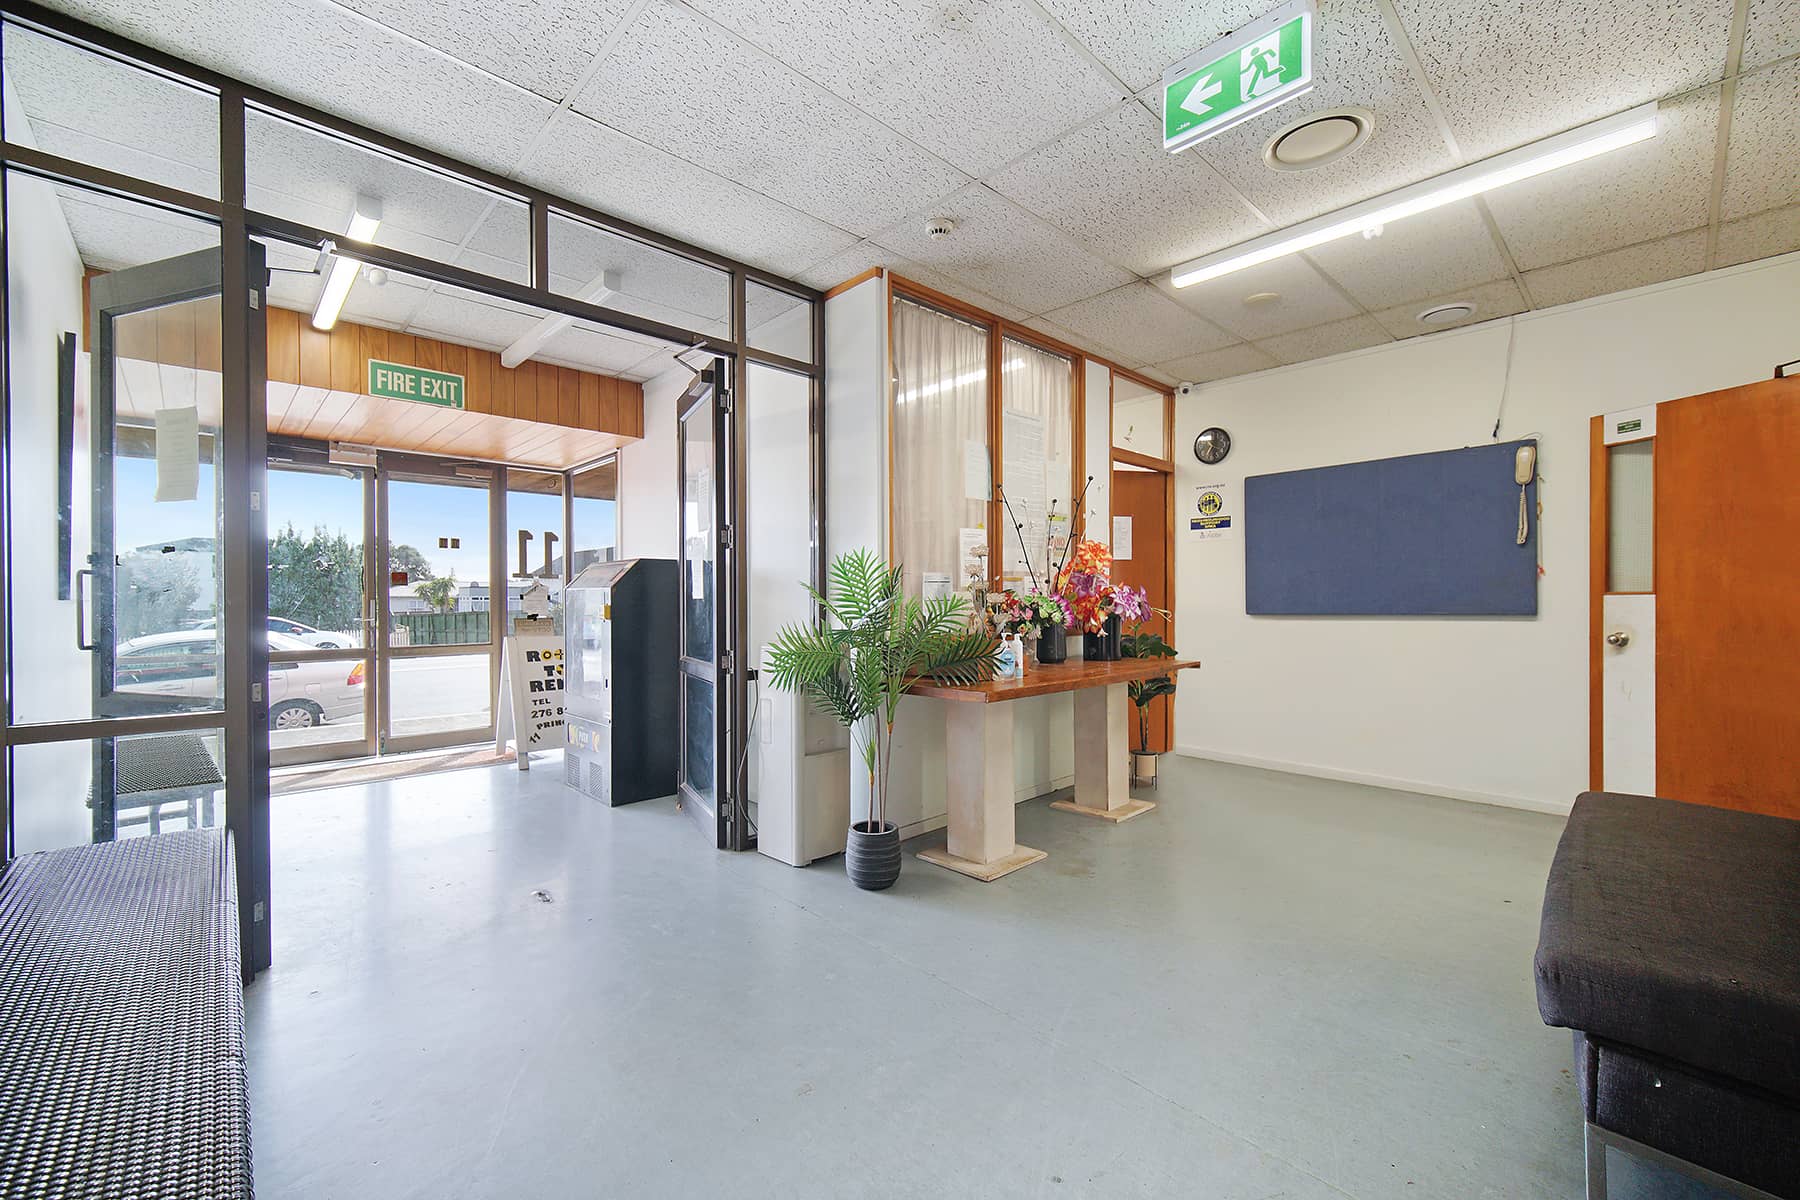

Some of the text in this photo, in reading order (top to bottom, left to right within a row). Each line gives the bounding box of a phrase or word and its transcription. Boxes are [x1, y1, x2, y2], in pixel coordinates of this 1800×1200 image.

[377, 368, 458, 402] FIRE EXIT
[531, 698, 551, 706] TEL
[531, 708, 552, 719] 276
